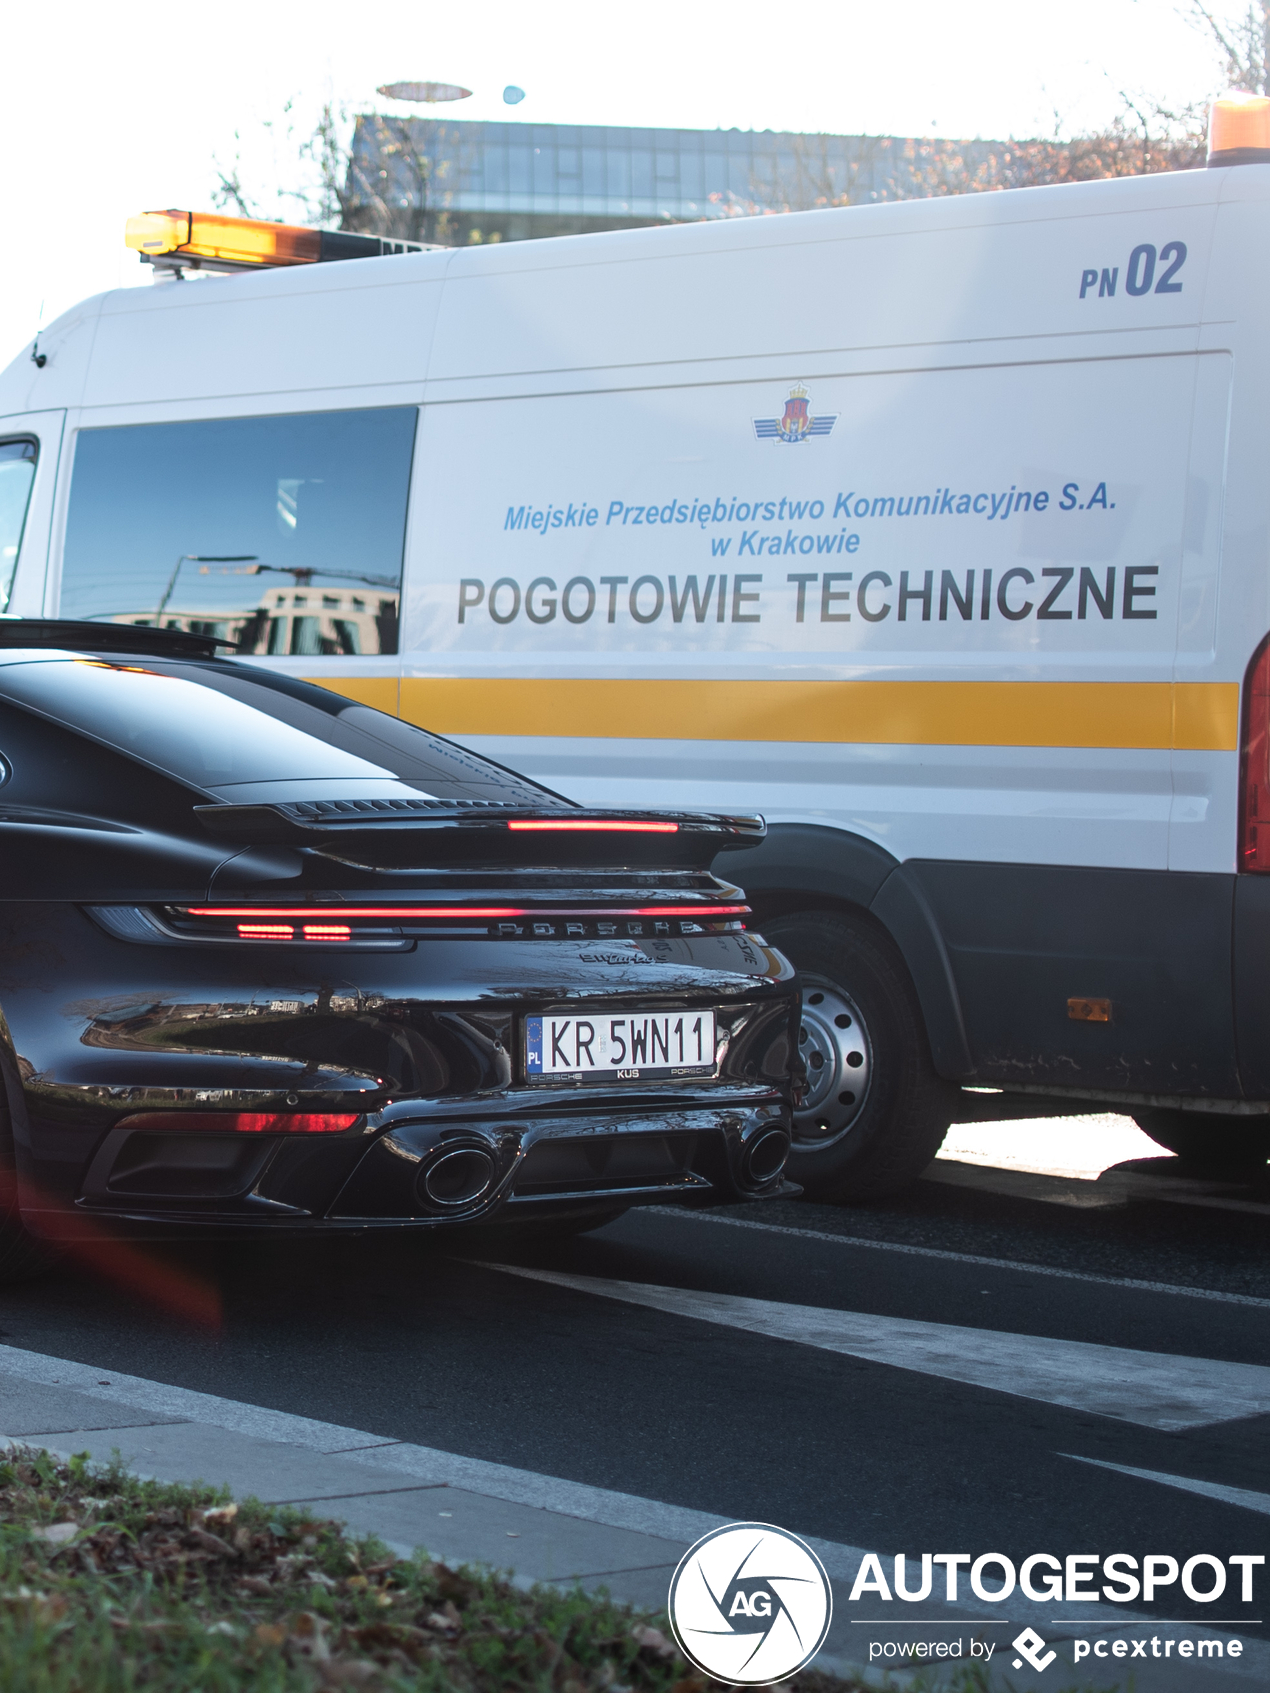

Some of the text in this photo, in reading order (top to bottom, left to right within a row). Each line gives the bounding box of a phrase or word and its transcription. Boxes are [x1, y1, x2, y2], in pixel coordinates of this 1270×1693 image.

[1079, 241, 1188, 299] PN 02
[503, 482, 1117, 535] Miejskie Przedsiębiorstwo Komunikacyjne S.A.
[710, 527, 861, 557] w Krakowie
[456, 565, 1160, 625] POGOTOWIE TECHNICZNE
[527, 1052, 542, 1065] PL
[551, 1016, 703, 1068] KR 5WN11
[530, 1067, 714, 1082] PORSCHE KUS PORSCHE
